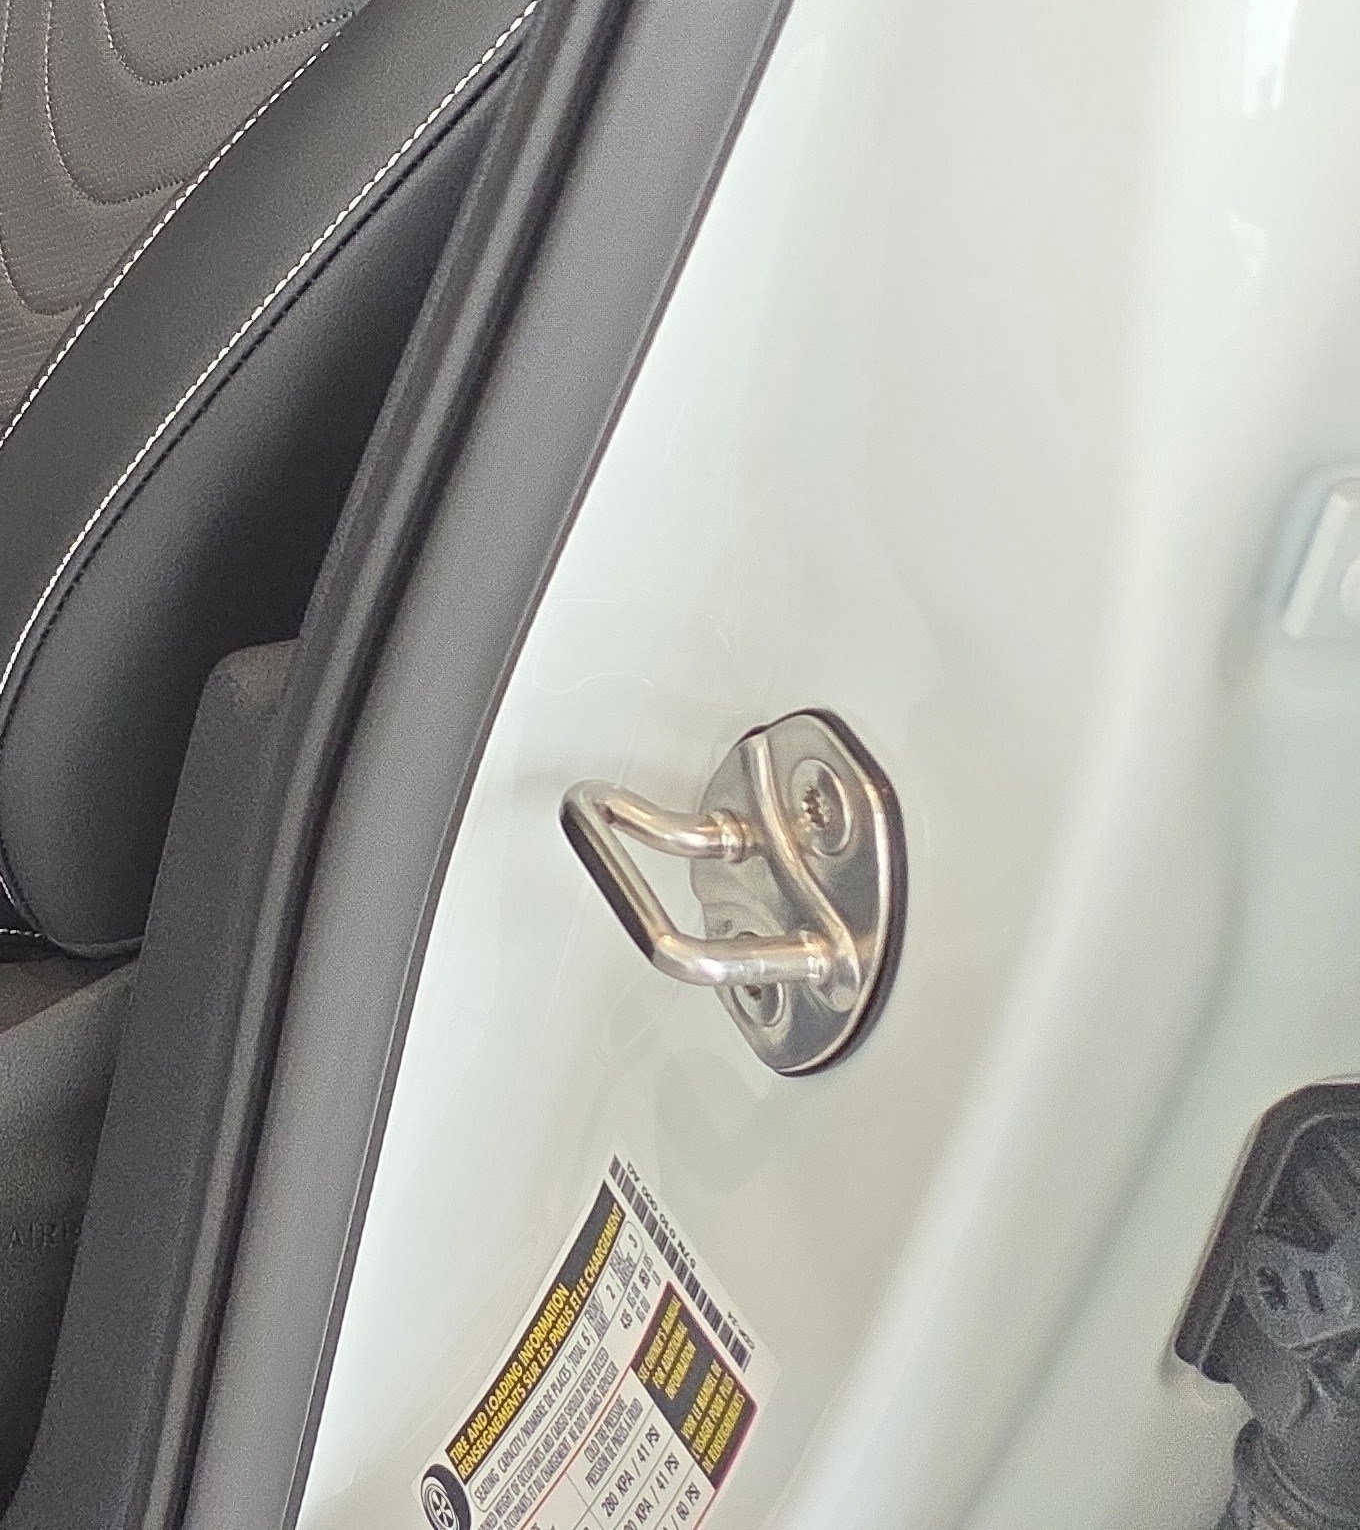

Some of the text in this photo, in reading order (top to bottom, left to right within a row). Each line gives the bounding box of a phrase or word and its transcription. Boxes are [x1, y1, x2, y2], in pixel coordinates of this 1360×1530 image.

[449, 1282, 570, 1464] TIRE AND LOADING INFORMATION
[457, 1202, 623, 1479] RENSEIGNEMENTS SUR LES PNEUS ET LE CHARGEMENT
[474, 1468, 501, 1503] SEATING
[542, 1388, 556, 1407] DE
[602, 1492, 619, 1517] 280
[615, 1469, 634, 1496] KPA
[634, 1443, 649, 1462] 41
[645, 1424, 660, 1448] PSI
[635, 1497, 654, 1524] KPA
[655, 1470, 669, 1489] 41
[664, 1452, 680, 1476] PSI
[685, 1482, 700, 1506] PSI
